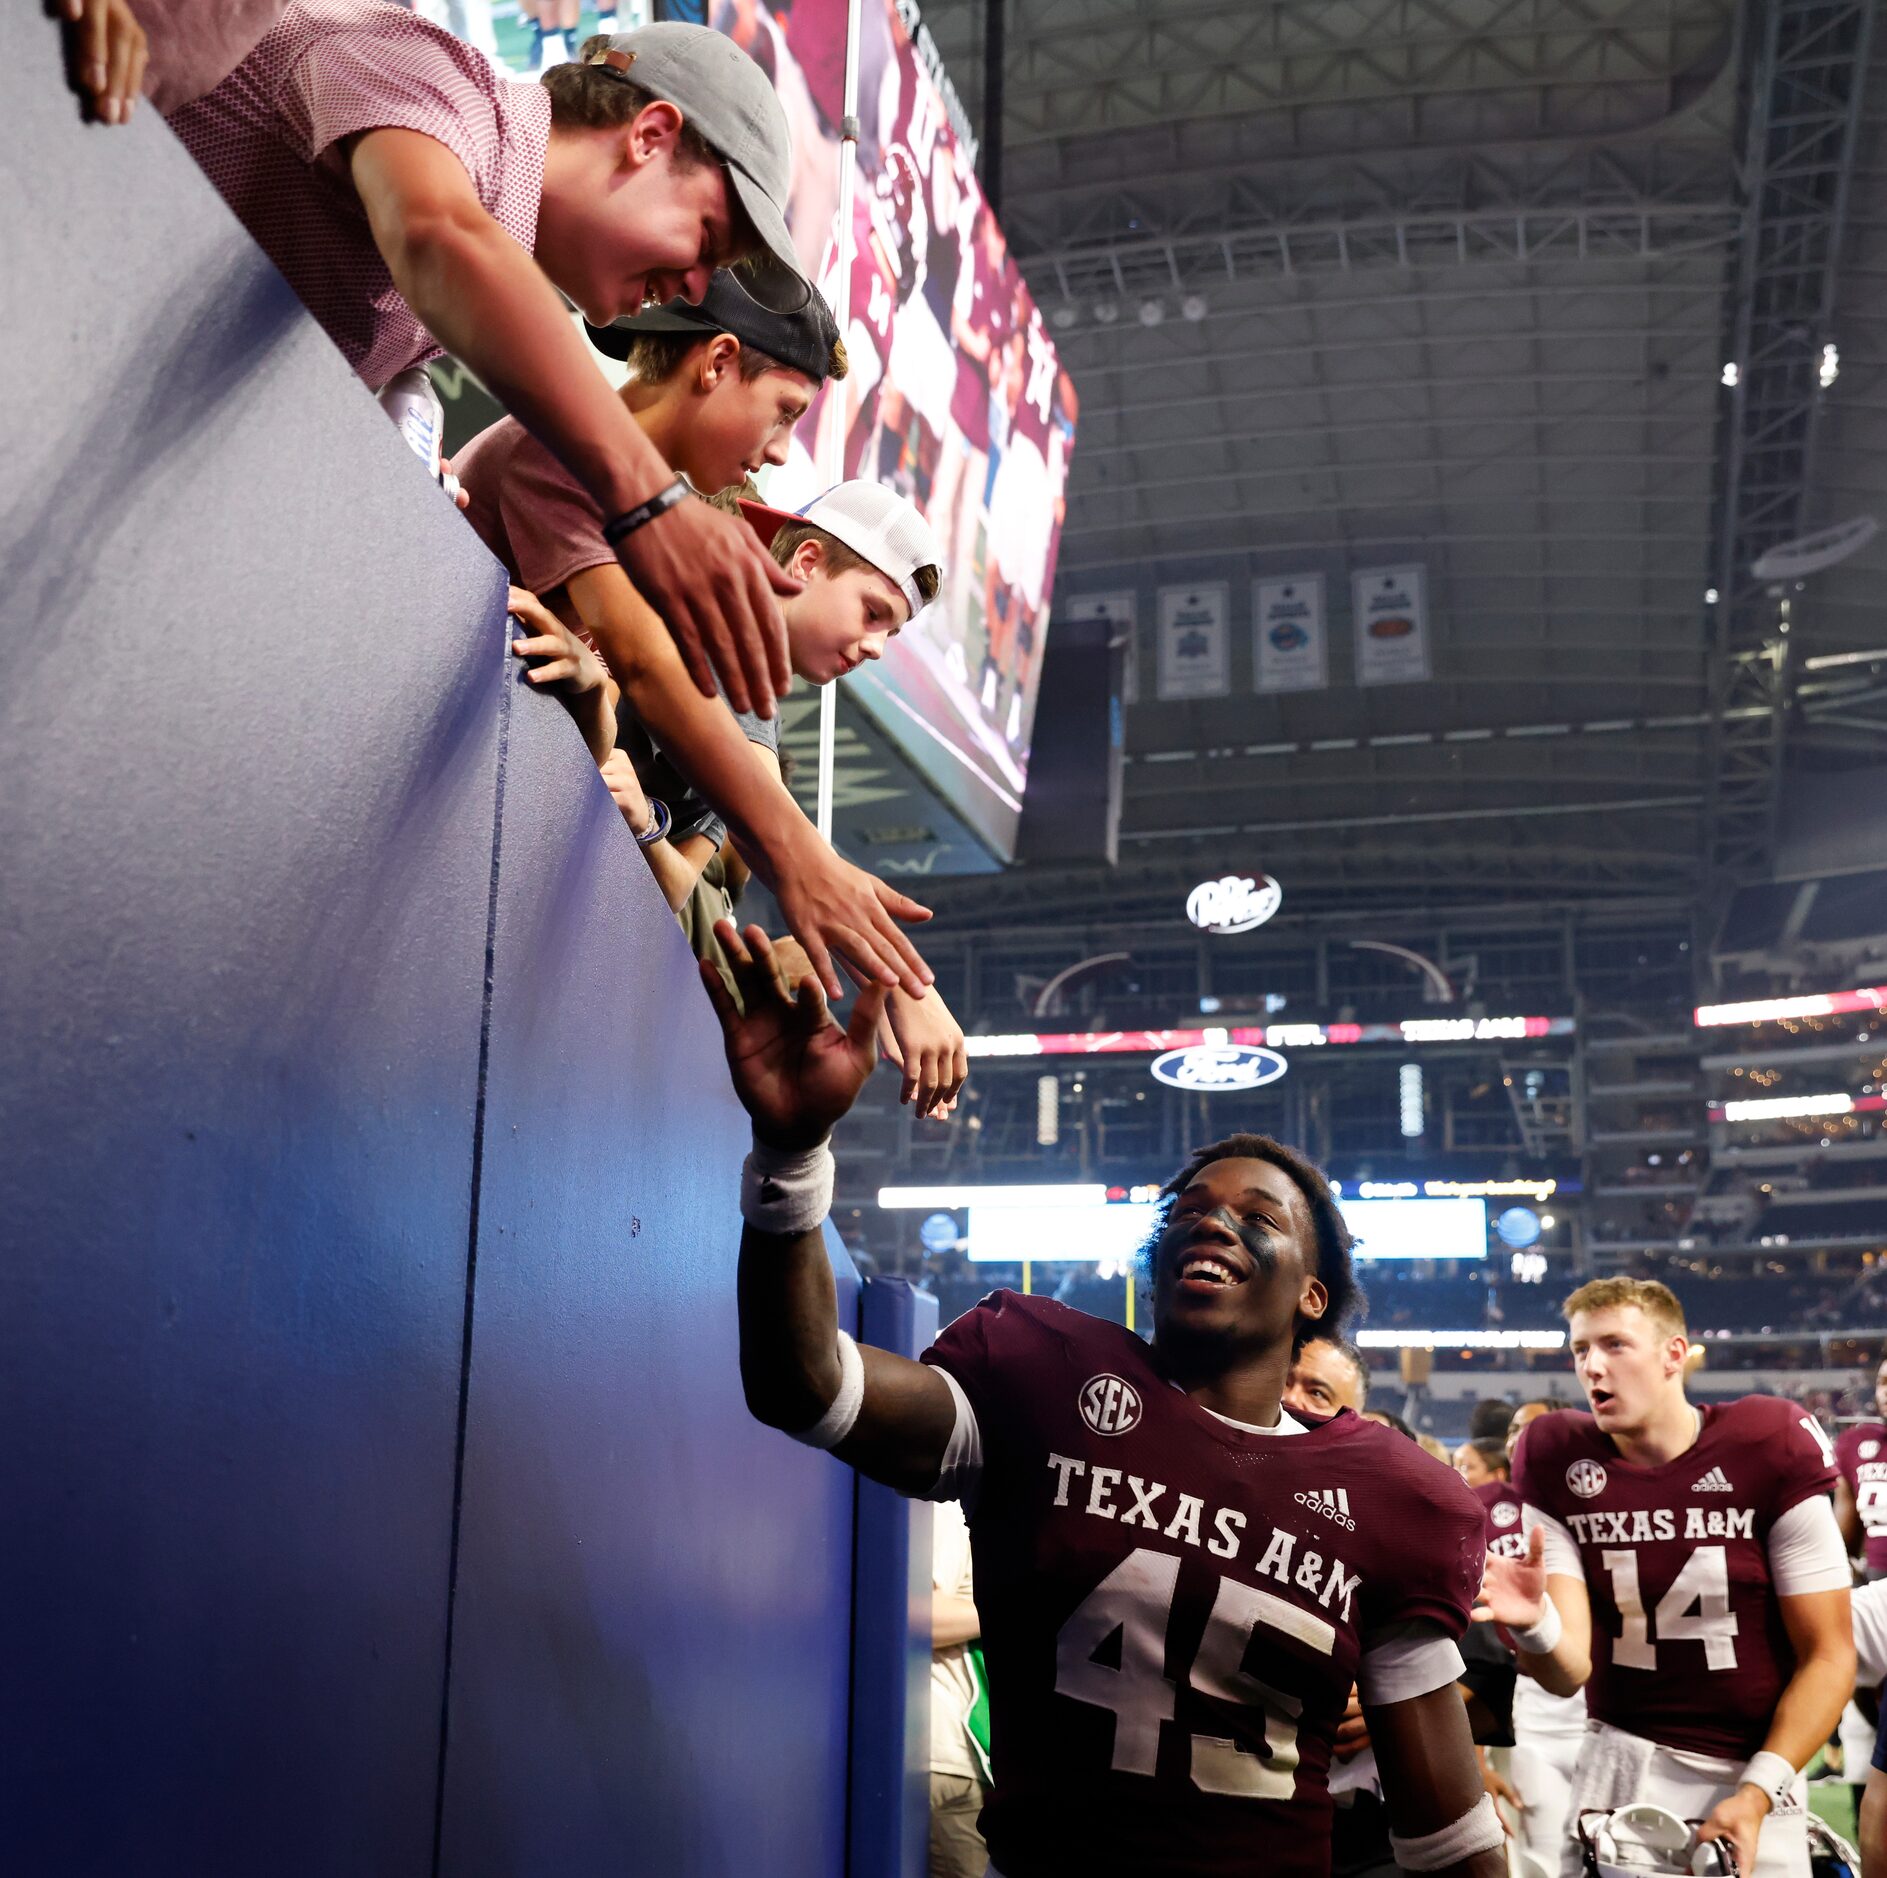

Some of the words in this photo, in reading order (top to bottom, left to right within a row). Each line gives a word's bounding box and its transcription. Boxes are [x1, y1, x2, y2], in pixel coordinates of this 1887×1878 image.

[1083, 1379, 1137, 1431] SEC
[1293, 1492, 1357, 1532] adidas
[1691, 1482, 1734, 1493] adidas
[1047, 1452, 1248, 1560] TEXAS
[1254, 1527, 1363, 1624] A&M
[1566, 1508, 1676, 1544] TEXAS
[1684, 1507, 1756, 1540] A&M
[1601, 1545, 1739, 1672] 14
[1054, 1547, 1336, 1801] 45
